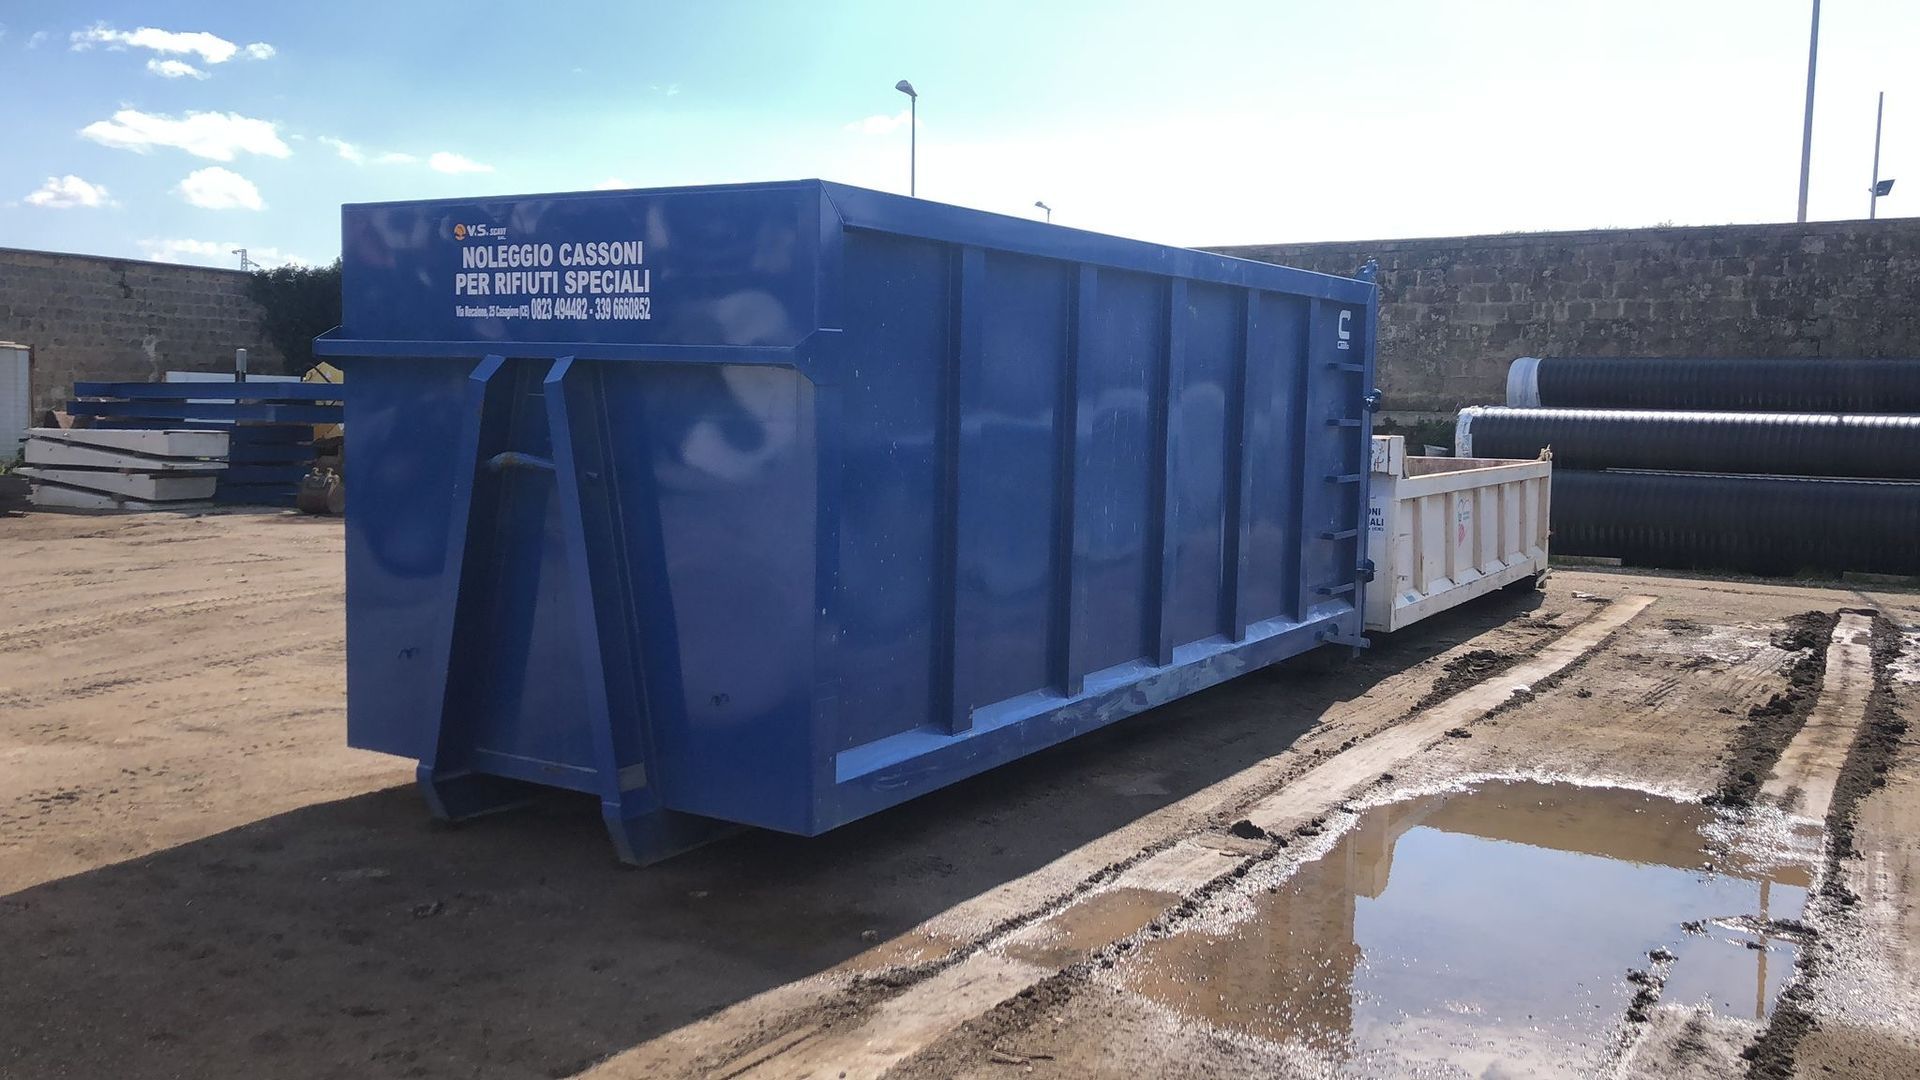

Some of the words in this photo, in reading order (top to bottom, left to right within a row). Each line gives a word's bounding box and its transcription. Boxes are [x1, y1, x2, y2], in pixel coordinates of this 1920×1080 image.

[462, 243, 553, 268] NOLEGGIO
[559, 241, 643, 266] CASSONI
[455, 273, 490, 295] PER
[494, 271, 559, 294] RIFIUTI
[564, 269, 650, 294] SPECIALI
[531, 298, 552, 320] 0823
[554, 298, 588, 320] 494482
[594, 297, 611, 320] 339
[613, 297, 651, 320] 6660852
